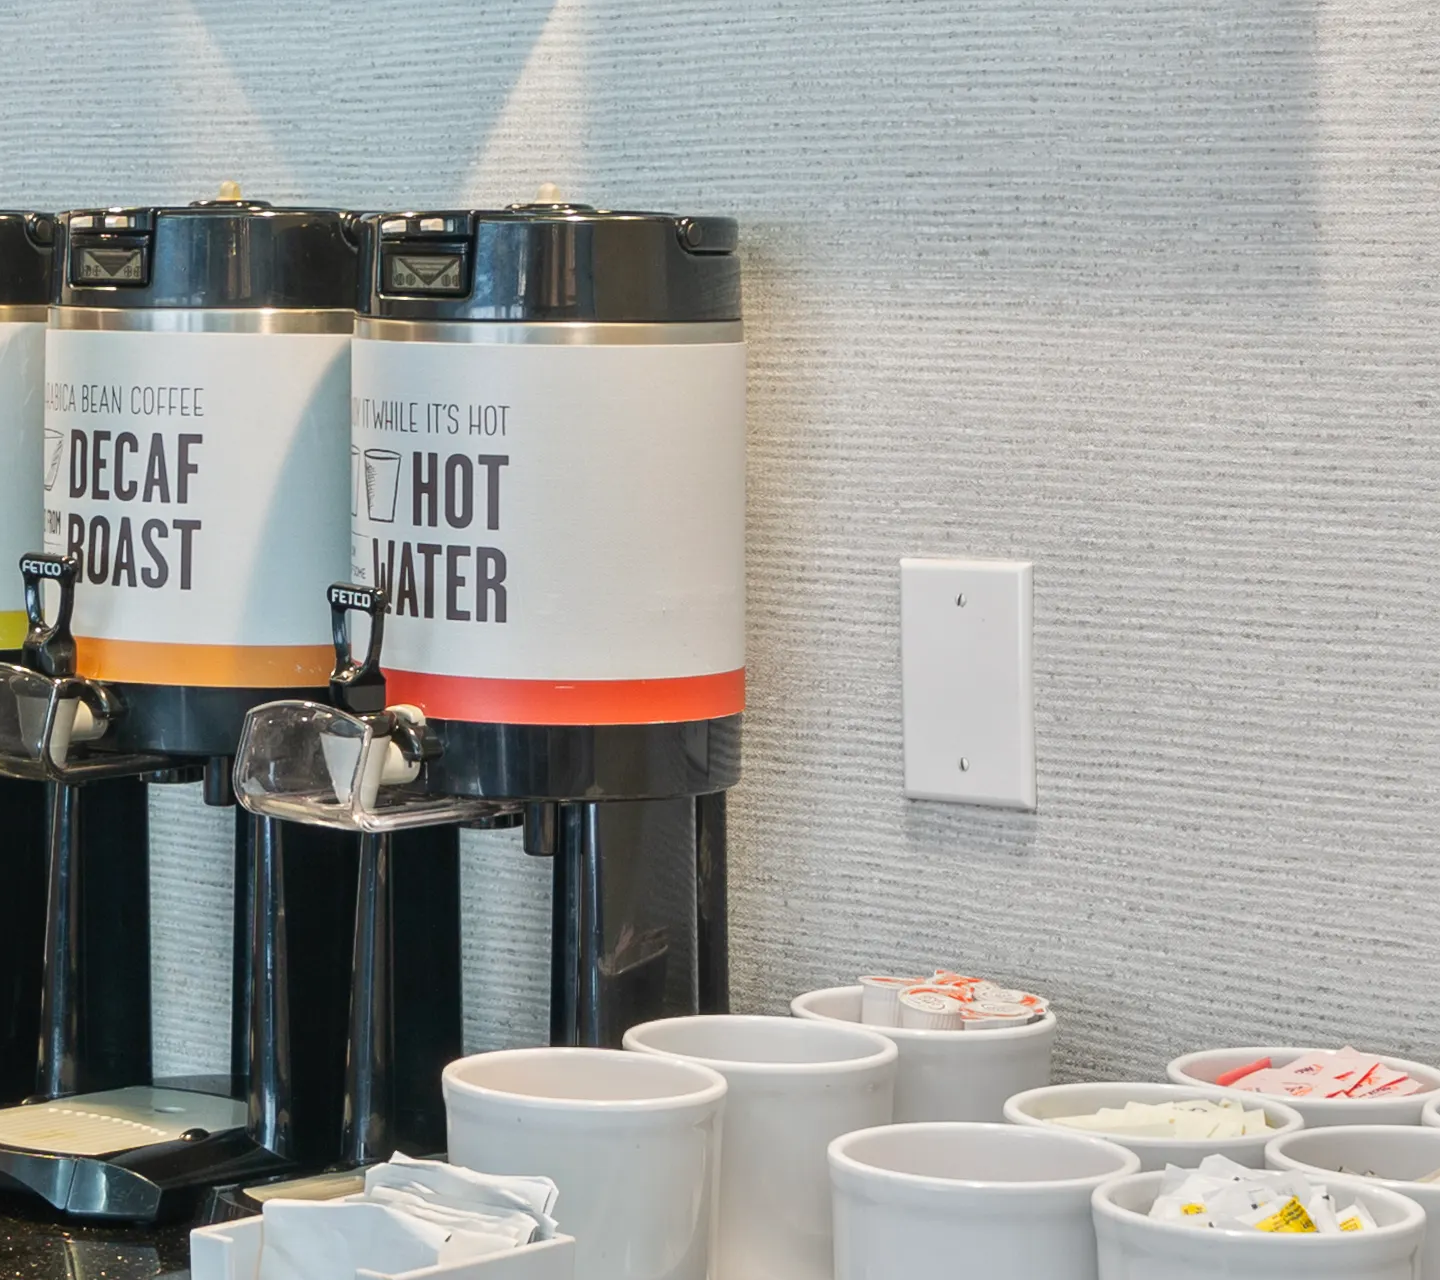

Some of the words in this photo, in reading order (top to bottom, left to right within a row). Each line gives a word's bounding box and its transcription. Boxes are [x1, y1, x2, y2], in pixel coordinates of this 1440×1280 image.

[81, 384, 122, 414] BEAN
[130, 386, 205, 417] COFFEE
[372, 400, 418, 433] WHILE
[427, 403, 460, 435] IT'S
[469, 404, 511, 437] HOT
[69, 428, 203, 504] DECAF
[412, 451, 510, 531] HOT
[22, 560, 61, 577] FETCO
[67, 512, 202, 591] ROAST
[331, 589, 371, 608] FETCO
[372, 537, 508, 624] WATER
